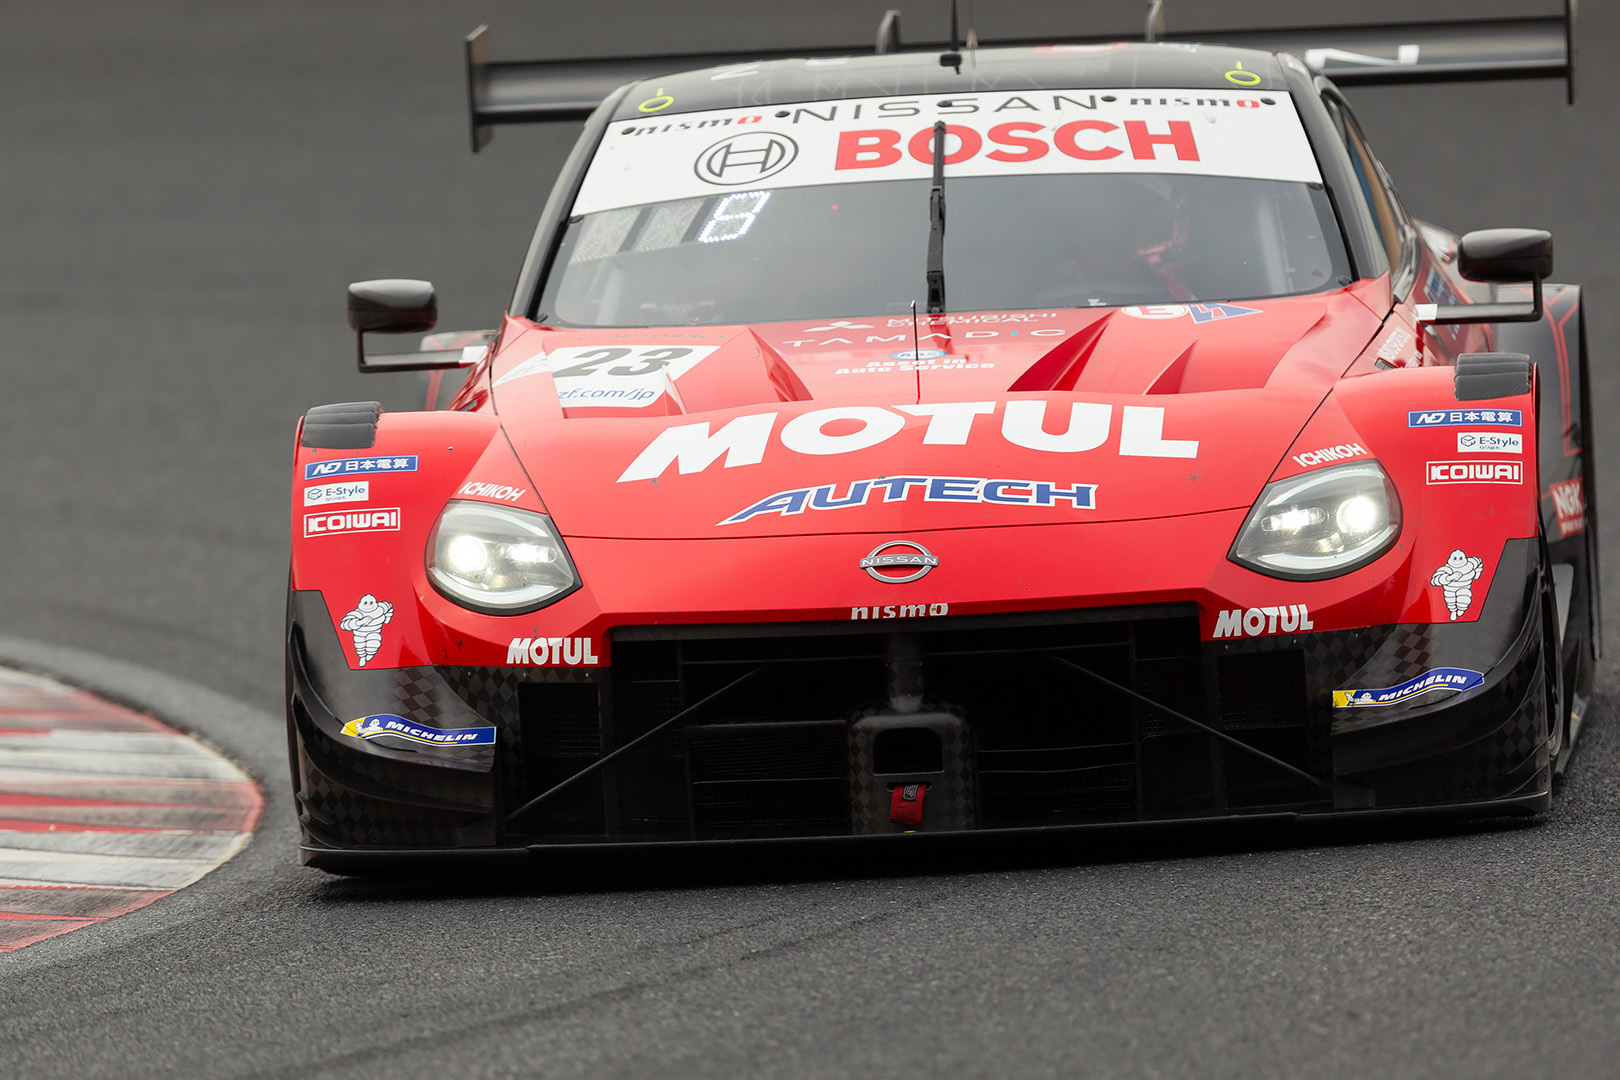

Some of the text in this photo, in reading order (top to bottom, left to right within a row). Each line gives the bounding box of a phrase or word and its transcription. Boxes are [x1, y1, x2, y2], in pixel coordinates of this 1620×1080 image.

[792, 95, 1097, 124] NISSAN
[1129, 96, 1261, 109] nismo
[634, 115, 763, 137] nismo
[834, 120, 1201, 171] BOSCH
[782, 329, 1066, 347] TAMADIC
[553, 347, 694, 378] 23
[834, 366, 893, 375] Auto
[1450, 411, 1514, 423] 日本電算
[615, 400, 1200, 483] MOTUL
[1479, 436, 1519, 447] E-Style
[345, 458, 410, 471] 日本電算
[1292, 442, 1368, 468] ICHIKOH
[1430, 464, 1519, 481] KOIWAI
[325, 485, 366, 497] E-Style
[457, 481, 527, 502] ICHIKOH
[714, 475, 1099, 527] AUTECH
[1552, 481, 1583, 519] NGK
[308, 511, 398, 533] KOIWAI
[861, 556, 937, 567] NISSAN
[850, 602, 949, 620] nismo
[1212, 604, 1314, 638] MOTUL
[506, 637, 599, 665] MOTUL
[1378, 674, 1467, 702] MICHELIN
[385, 720, 478, 742] MICHELIN
